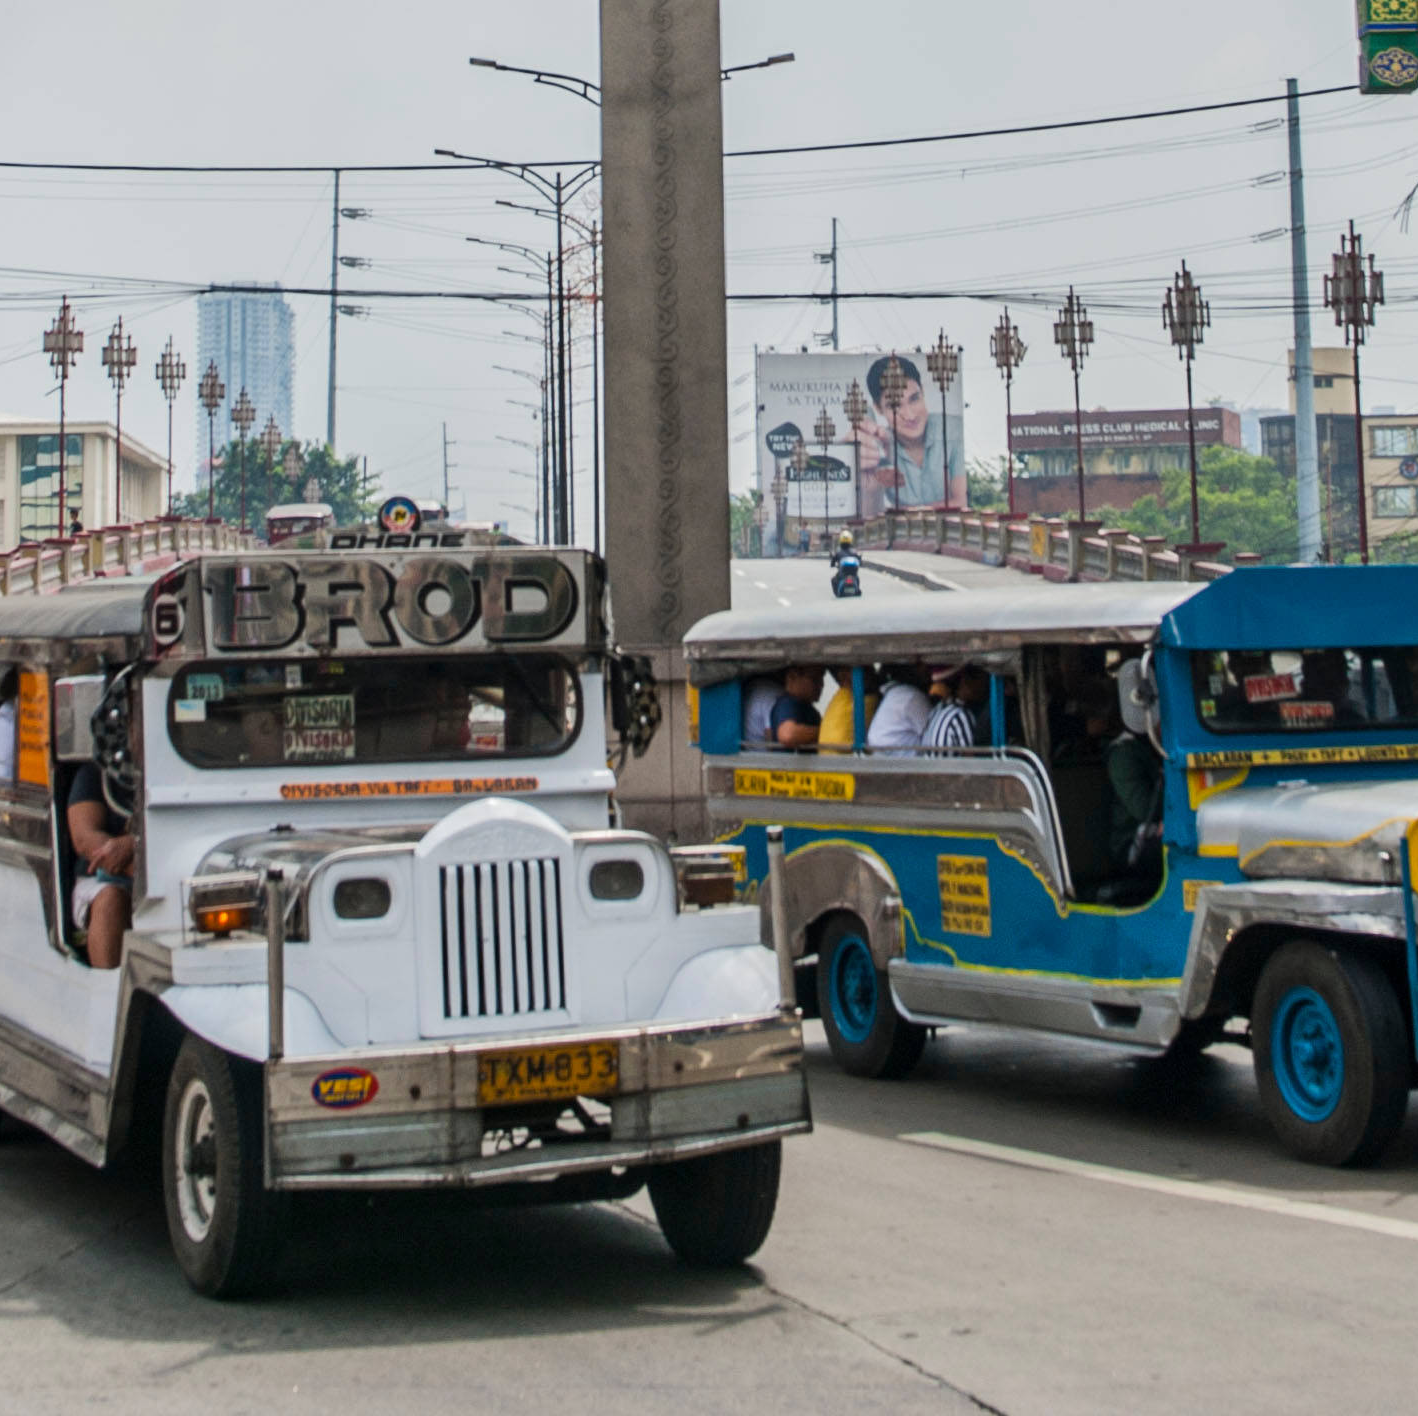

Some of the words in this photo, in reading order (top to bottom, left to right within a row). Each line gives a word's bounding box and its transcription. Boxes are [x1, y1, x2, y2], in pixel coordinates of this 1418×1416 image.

[1010, 425, 1061, 436] NATIONAL
[1102, 422, 1131, 433] CLUB
[1134, 421, 1181, 432] MEDICAL
[155, 602, 179, 636] 6
[203, 557, 579, 650] BROD
